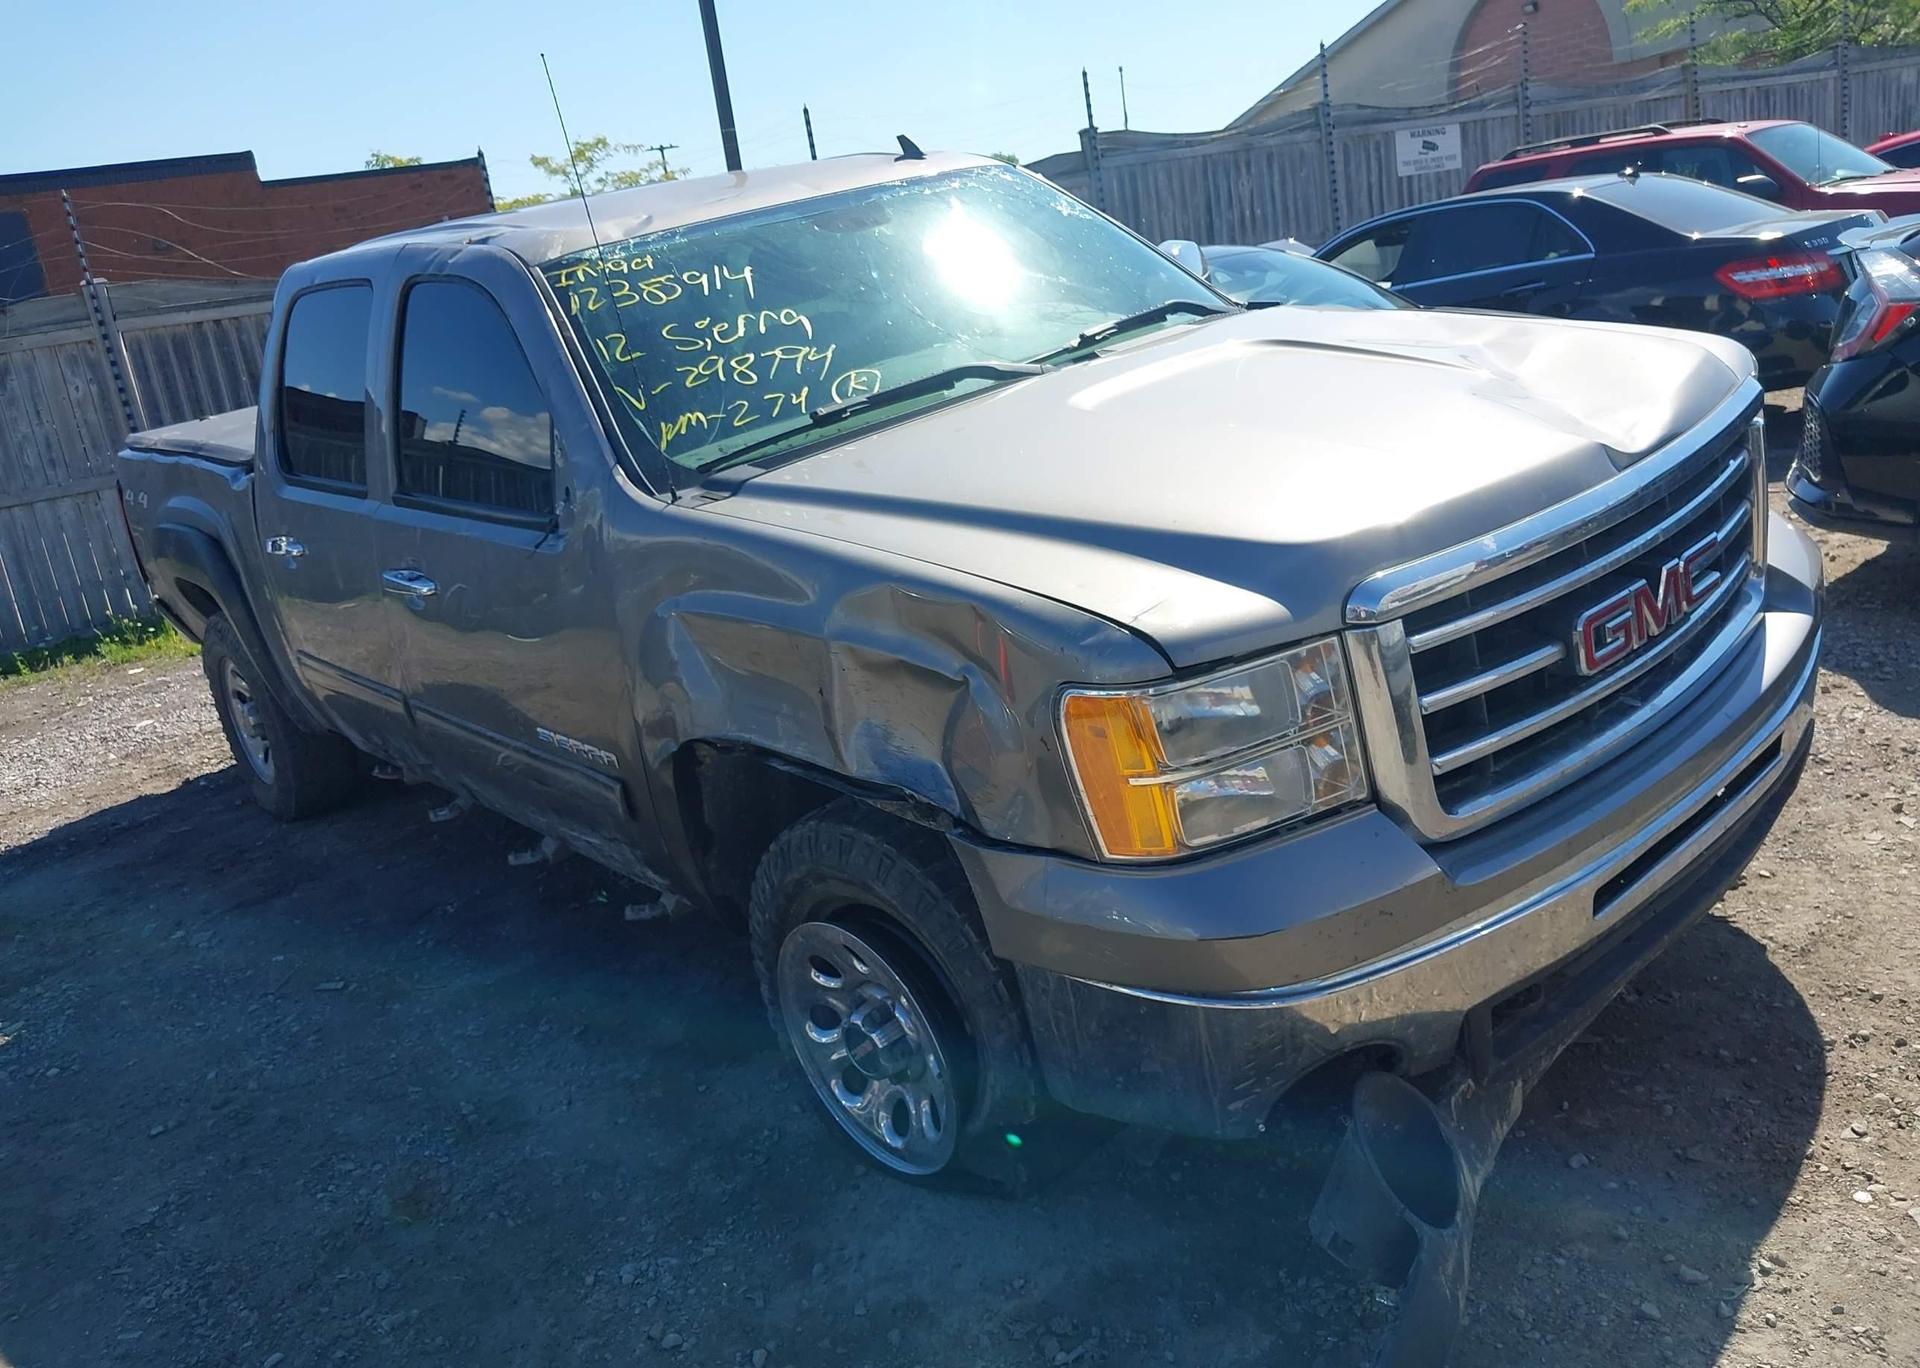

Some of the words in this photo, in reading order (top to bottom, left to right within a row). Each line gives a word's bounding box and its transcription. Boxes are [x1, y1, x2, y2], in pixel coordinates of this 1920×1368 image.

[1409, 126, 1447, 139] WARNING
[596, 333, 646, 363] 12
[662, 308, 812, 351] Sierra
[1573, 531, 1721, 676] GMC
[536, 727, 619, 769] SIERRA
